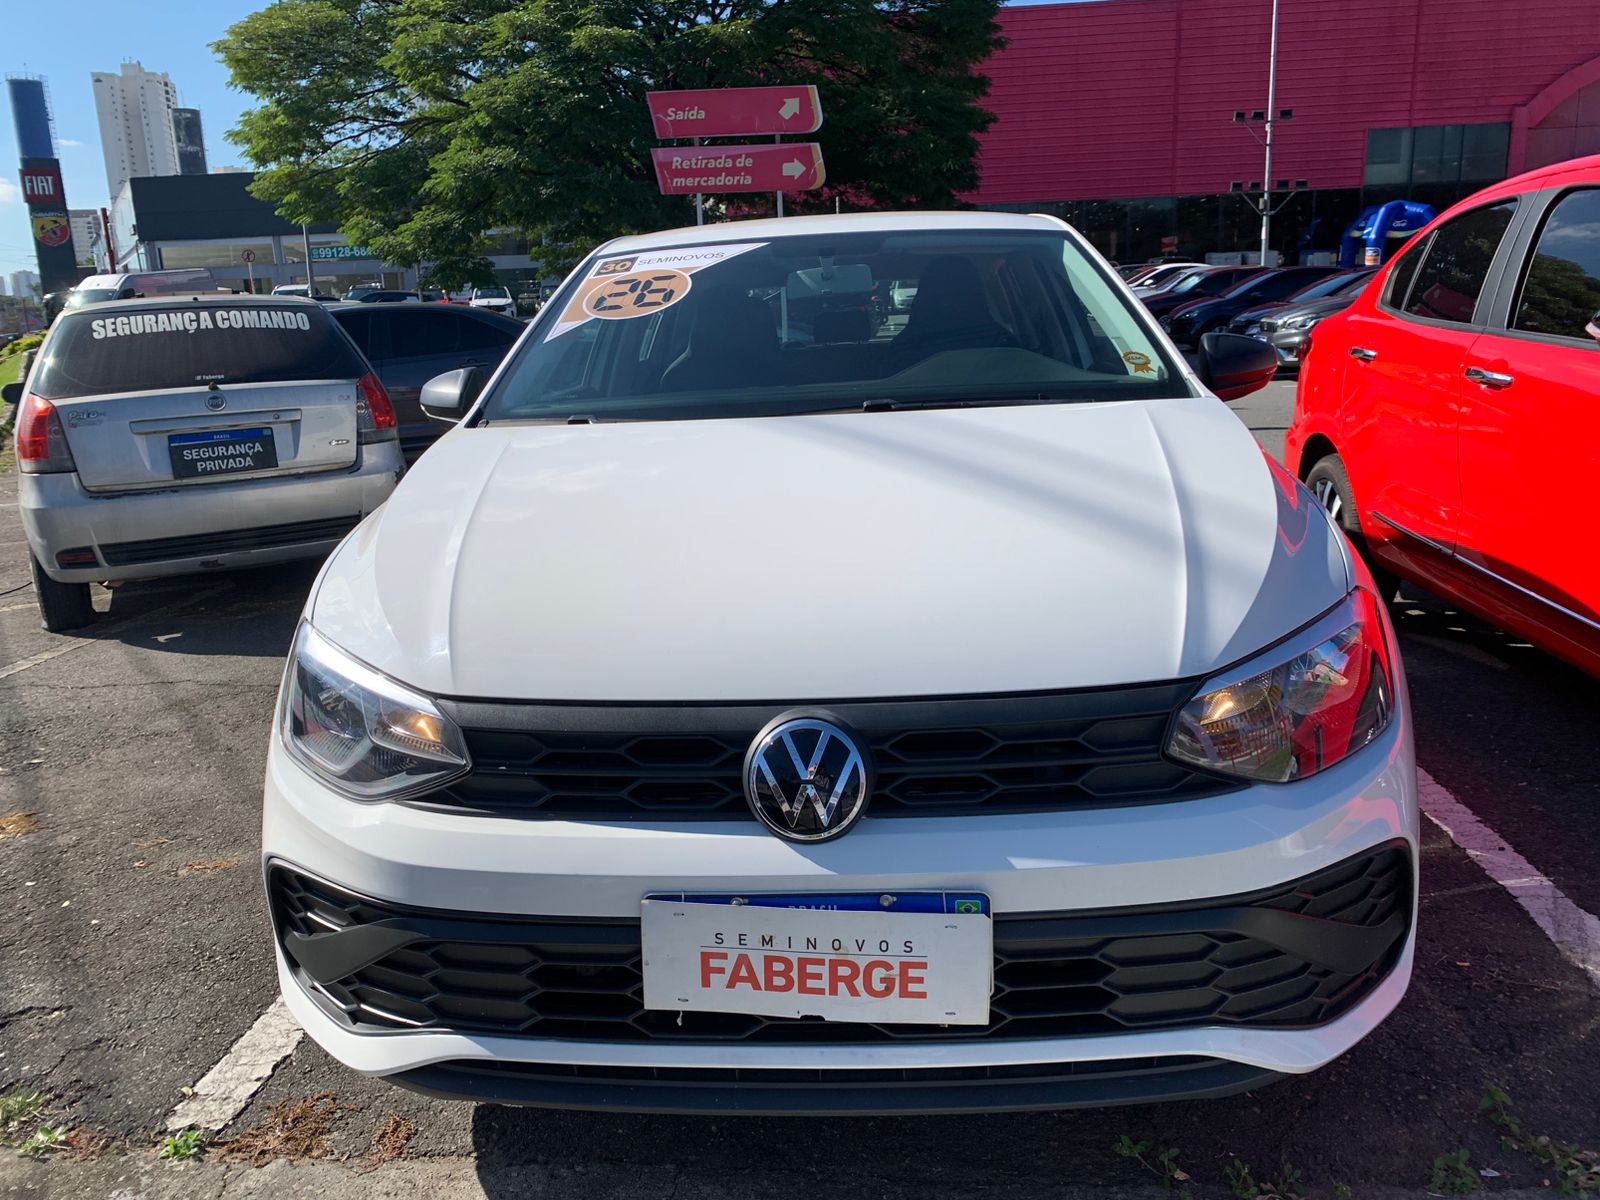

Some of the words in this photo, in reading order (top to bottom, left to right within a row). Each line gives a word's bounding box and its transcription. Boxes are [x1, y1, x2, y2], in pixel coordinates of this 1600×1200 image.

[667, 106, 706, 121] Saída
[671, 156, 733, 170] Retirada
[735, 154, 753, 168] de
[24, 175, 54, 196] FIAT
[672, 173, 753, 188] mercadoria
[601, 261, 632, 273] 30
[637, 251, 726, 266] SEMINOVOS
[593, 274, 677, 312] 26
[215, 310, 310, 331] COMANDO
[182, 442, 263, 460] SEGURANÇA
[196, 456, 254, 472] PRIVADA
[714, 932, 914, 954] SEMINOVOS
[699, 951, 929, 1000] FABERGE
